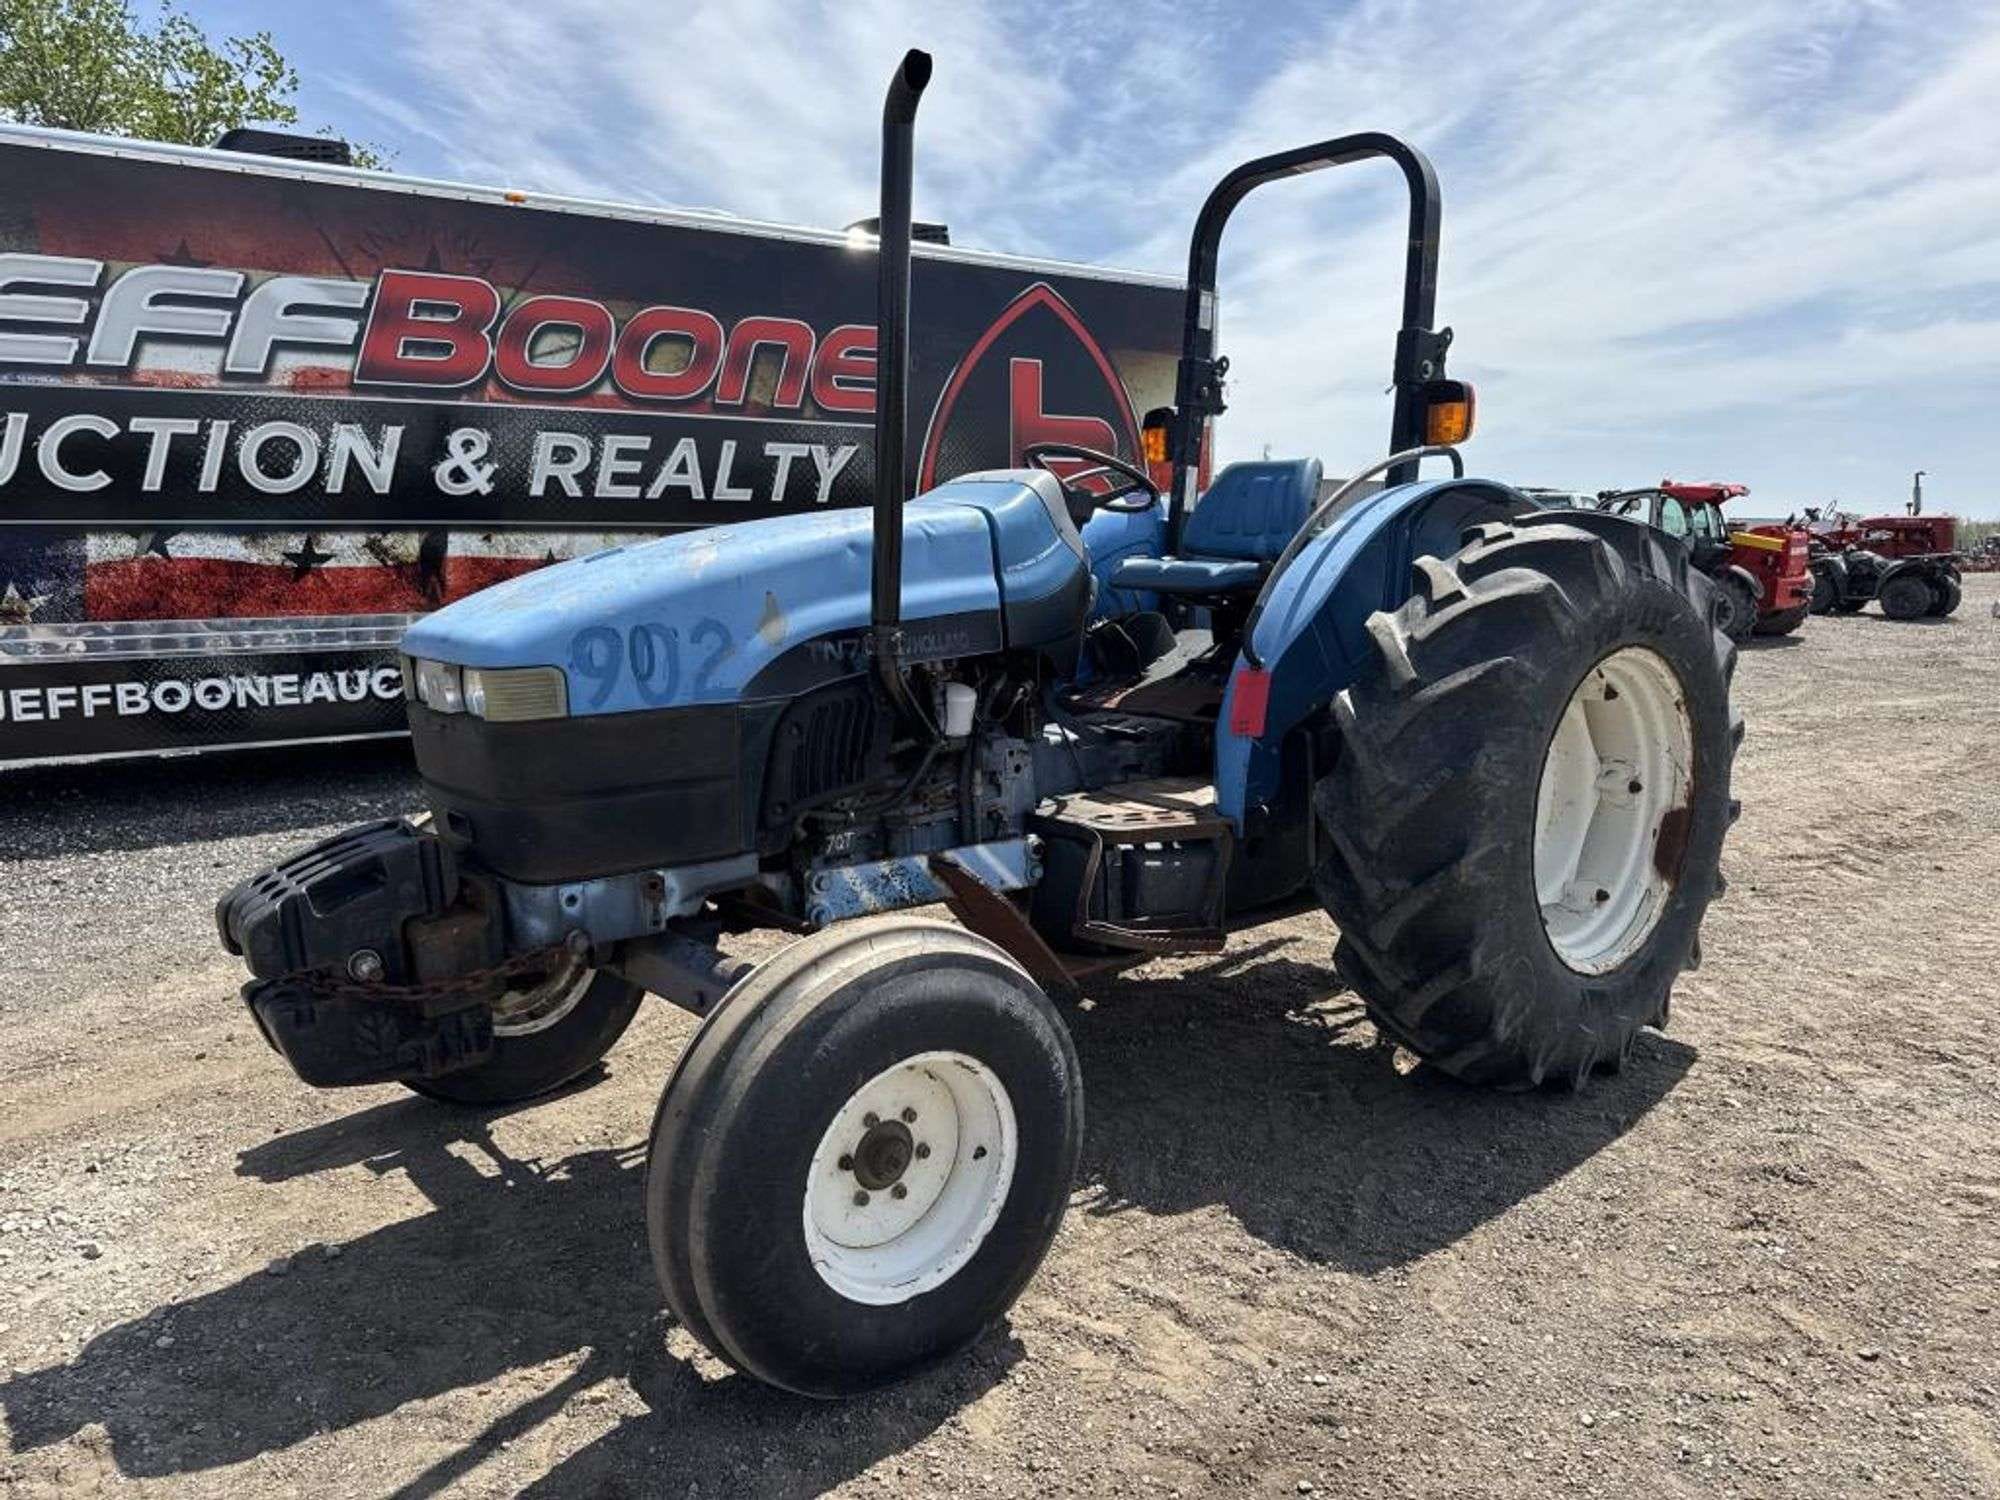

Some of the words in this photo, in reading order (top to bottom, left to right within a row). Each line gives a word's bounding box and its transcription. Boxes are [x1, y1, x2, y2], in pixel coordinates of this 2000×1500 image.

[433, 427, 499, 495] &
[528, 431, 859, 502] REALTY
[0, 668, 402, 722] EFFBOONEAUC
[571, 618, 737, 709] 902
